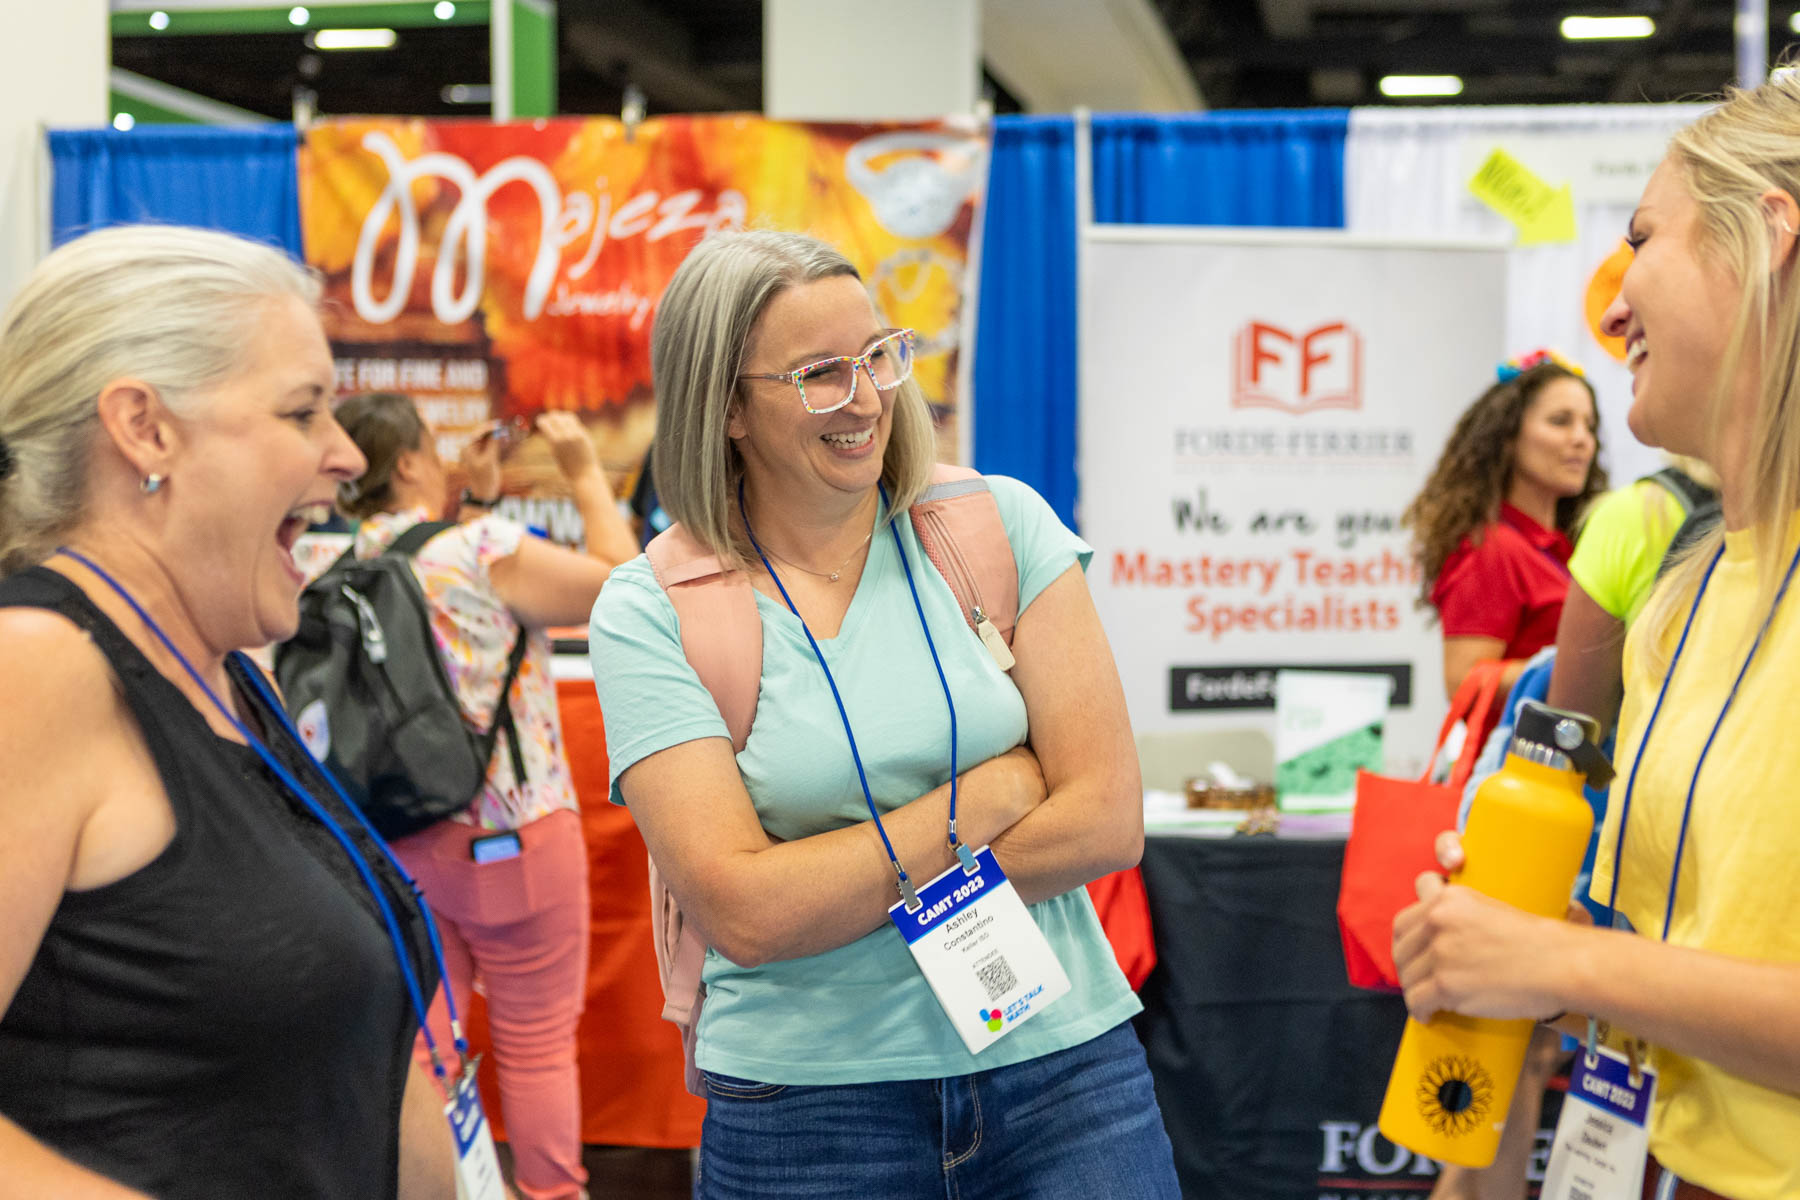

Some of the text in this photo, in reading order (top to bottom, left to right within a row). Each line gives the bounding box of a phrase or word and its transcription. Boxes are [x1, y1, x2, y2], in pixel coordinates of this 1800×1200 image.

[352, 130, 748, 324] Majeza
[1172, 488, 1230, 535] We
[1250, 511, 1315, 535] are
[1111, 551, 1281, 597] Mastery
[1186, 595, 1400, 642] Specialists
[917, 875, 985, 926] CAMT 2023
[945, 907, 979, 934] Ashley
[943, 915, 994, 951] Constantino
